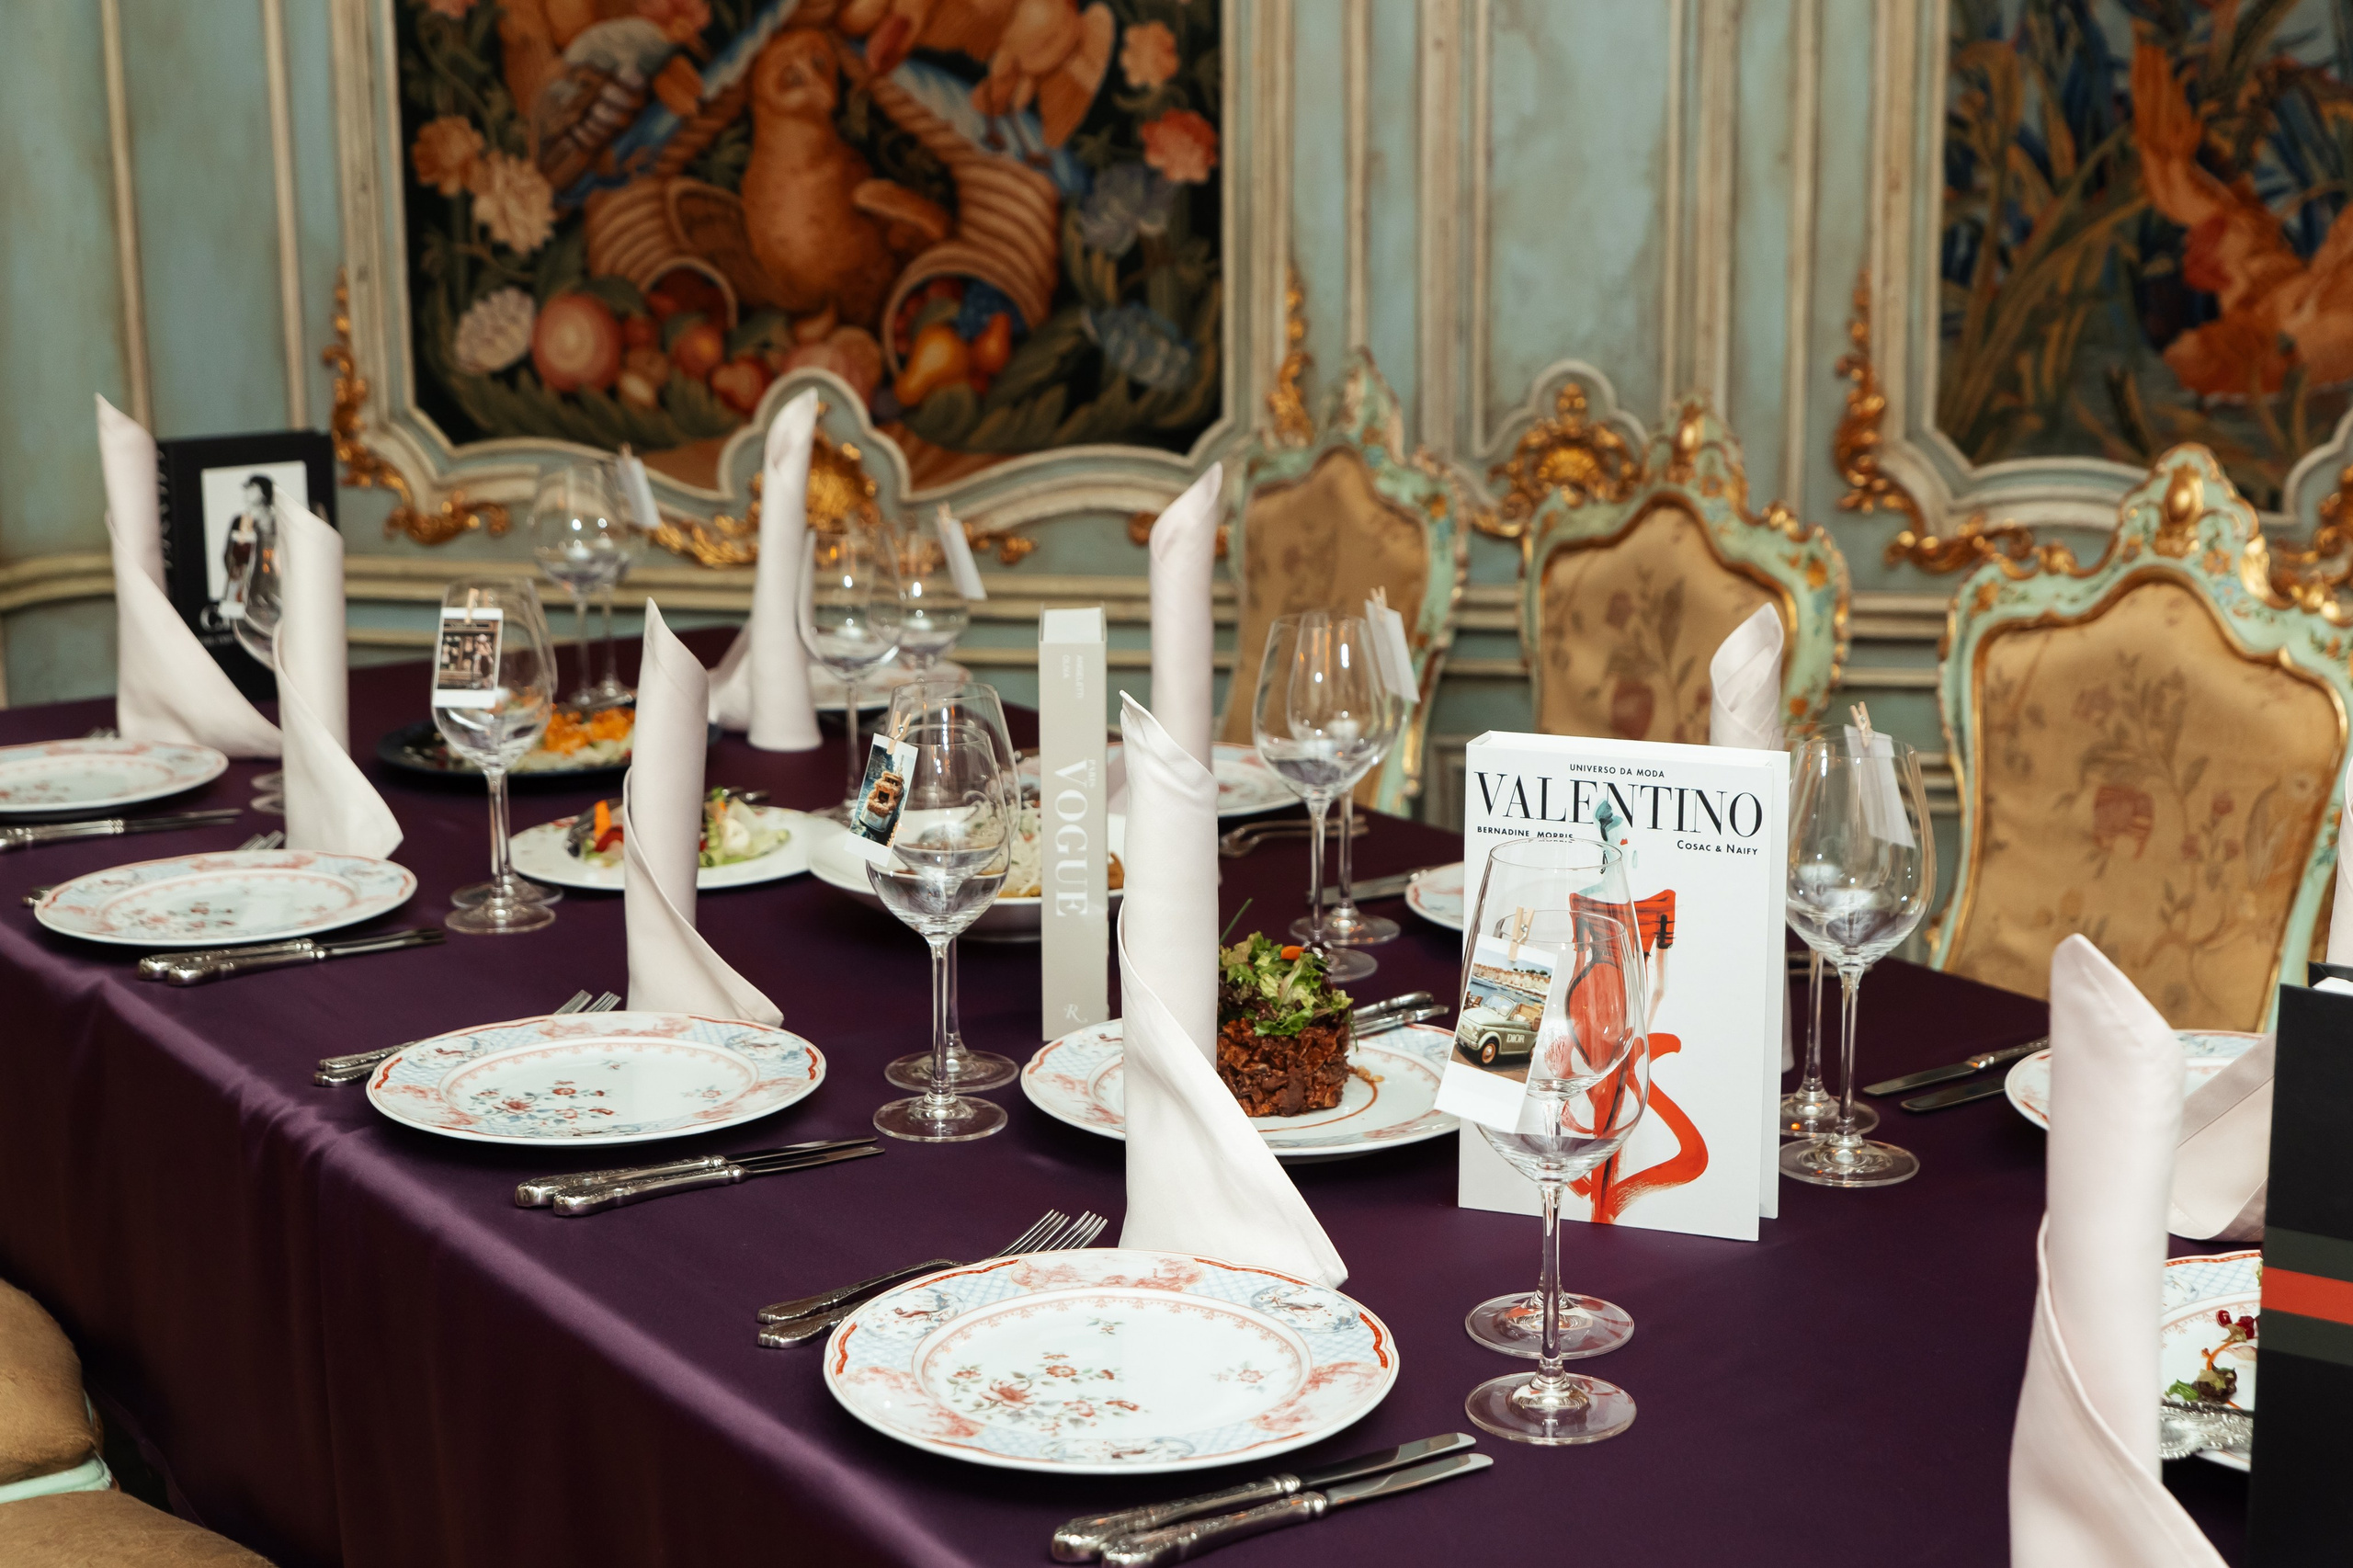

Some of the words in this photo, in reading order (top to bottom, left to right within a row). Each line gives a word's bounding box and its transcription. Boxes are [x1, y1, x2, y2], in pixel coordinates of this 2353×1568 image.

[1569, 763, 1617, 776] UNIVERSO
[1620, 767, 1633, 776] DA
[1636, 768, 1665, 778] MODA
[1473, 771, 1764, 838] VALENTINO
[1055, 758, 1088, 917] VOGUE
[1477, 825, 1529, 837] BERNADINE
[1715, 845, 1722, 853] &
[1506, 1033, 1525, 1043] DIOR
